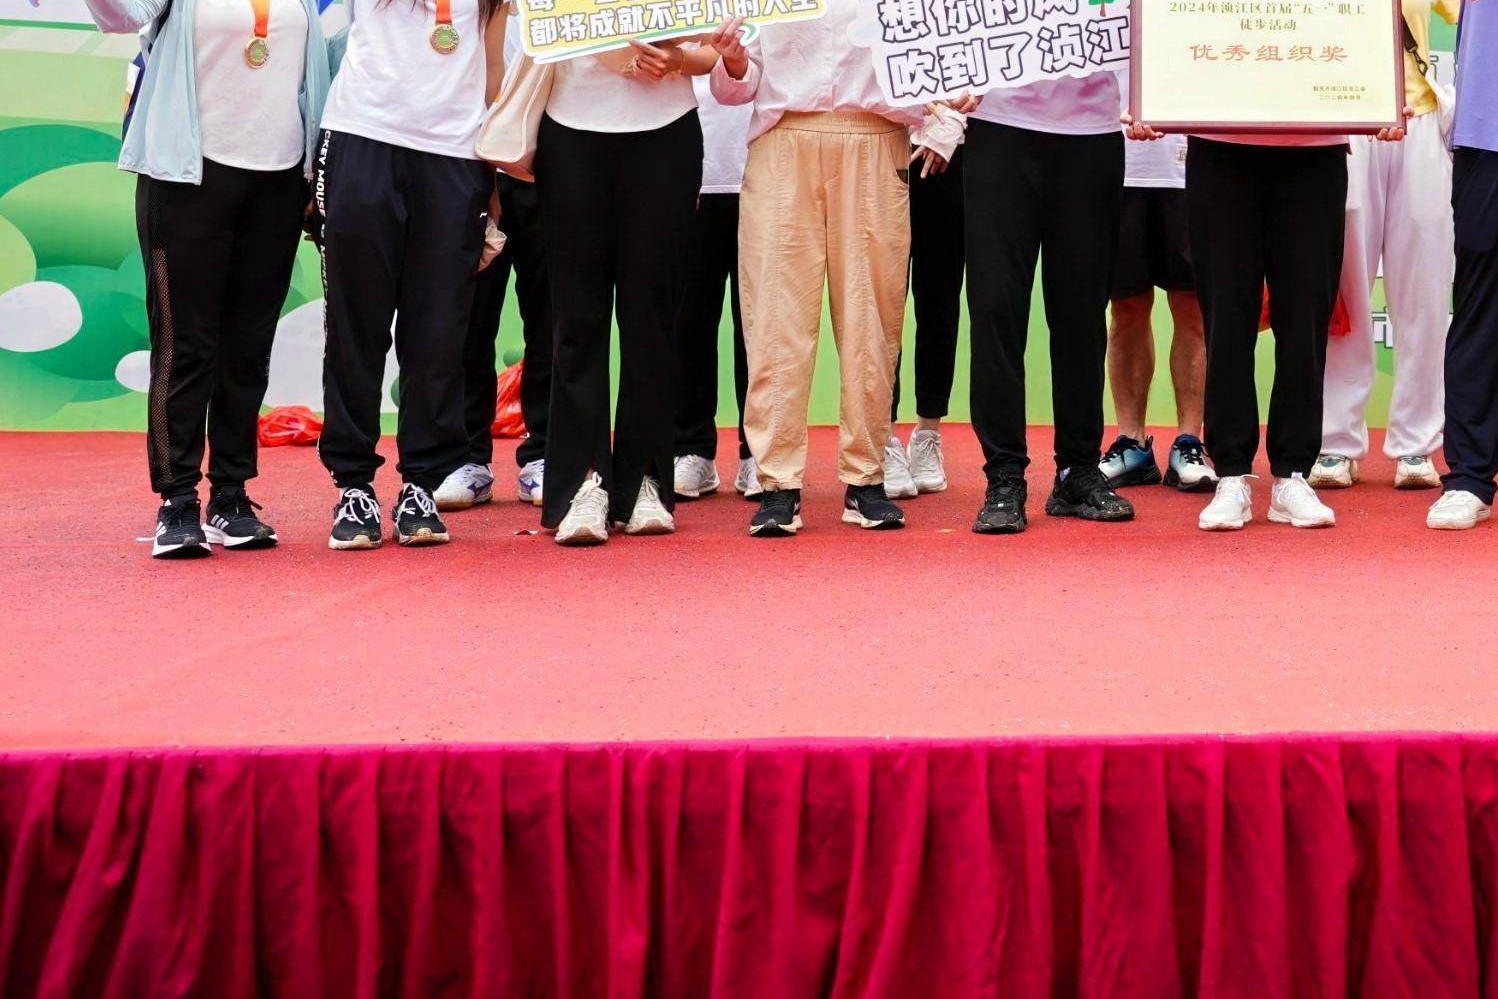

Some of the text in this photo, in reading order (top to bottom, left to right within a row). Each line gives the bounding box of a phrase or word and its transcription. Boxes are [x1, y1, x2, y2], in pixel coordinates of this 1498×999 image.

[1240, 19, 1297, 31] 徒步活动
[887, 16, 1130, 99] 吹到了浈江
[1189, 44, 1348, 63] 优秀组织奖
